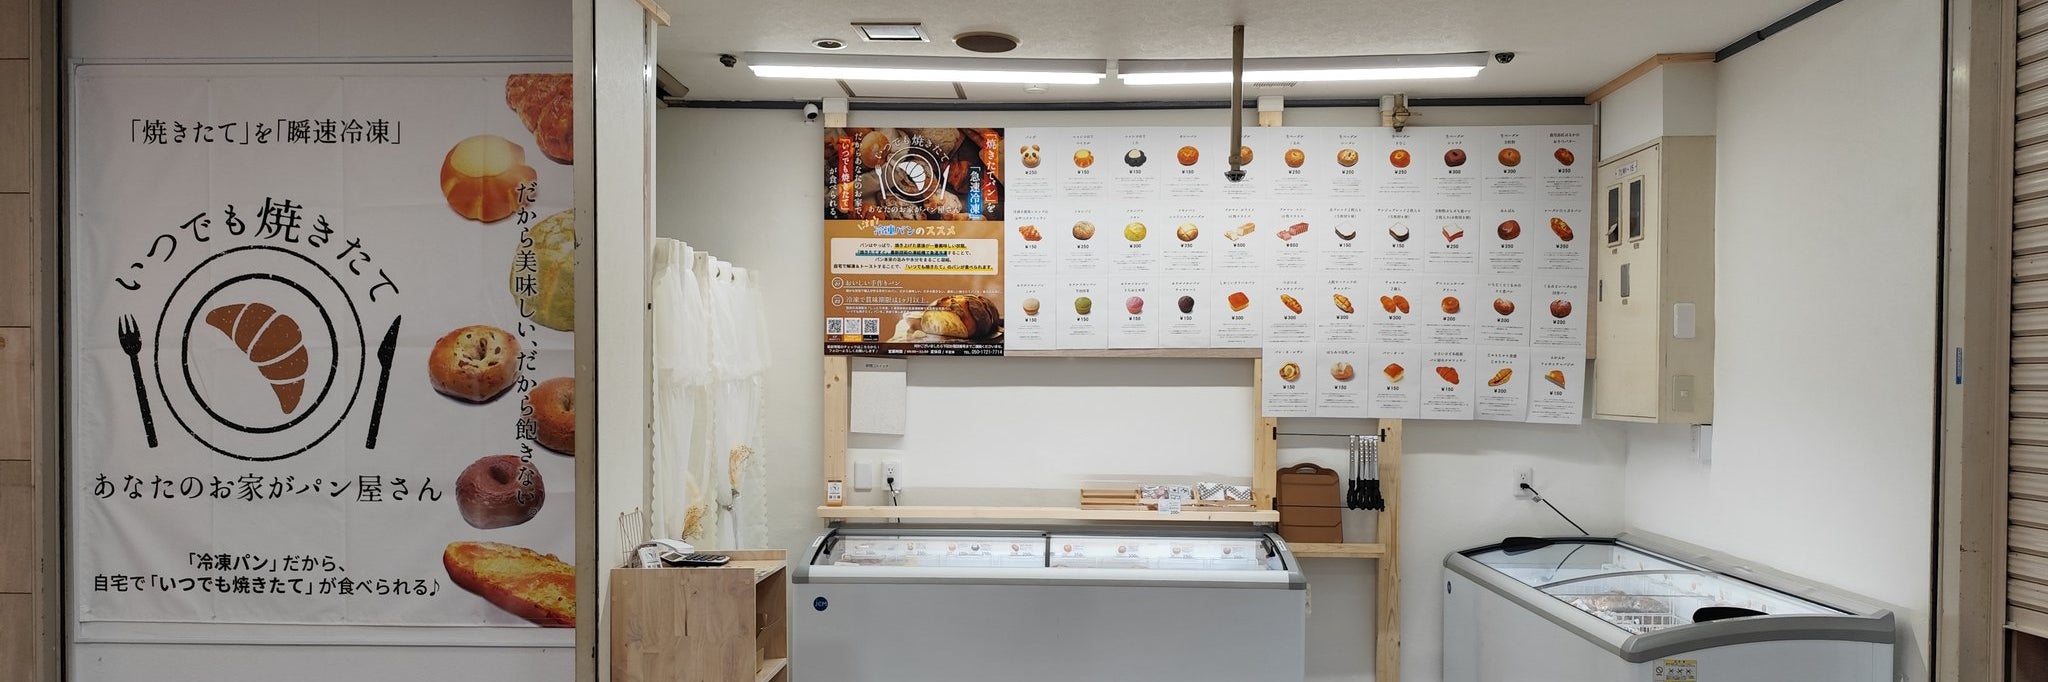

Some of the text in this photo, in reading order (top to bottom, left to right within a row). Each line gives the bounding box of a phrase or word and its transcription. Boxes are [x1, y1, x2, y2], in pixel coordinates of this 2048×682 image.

[131, 118, 402, 145] 「焼きたて」を「瞬速冷凍」
[875, 134, 950, 162] いつでも焼きたて
[839, 138, 850, 210] 「いつでも焼きたて」
[970, 167, 981, 218] 「急速冷凍」
[984, 133, 997, 213] 「焼きたてパン」を
[115, 197, 400, 303] いつでも焼きたて
[516, 181, 540, 518] だから美味しい、だから飽きない。
[94, 473, 443, 503] あなたのお家がパン屋さん
[188, 552, 348, 573] 「冷凍パン」だから、
